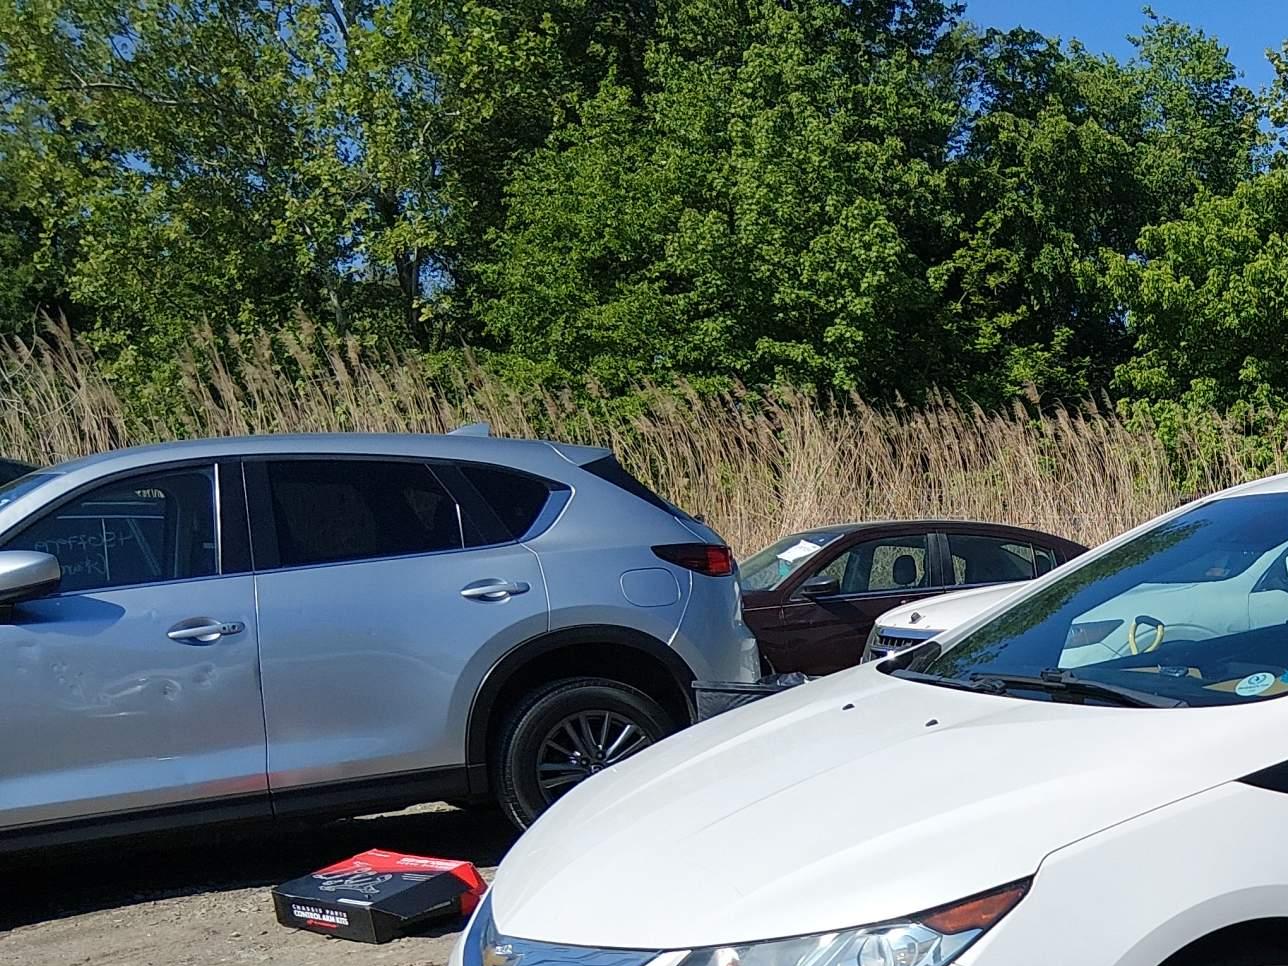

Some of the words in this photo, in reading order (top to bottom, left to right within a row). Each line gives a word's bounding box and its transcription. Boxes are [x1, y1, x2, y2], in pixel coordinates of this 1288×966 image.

[291, 903, 323, 914] CHASSIS
[325, 908, 348, 918] PARTS
[293, 909, 322, 921] CONTROL
[322, 914, 336, 923] ARM
[336, 916, 349, 926] KITS
